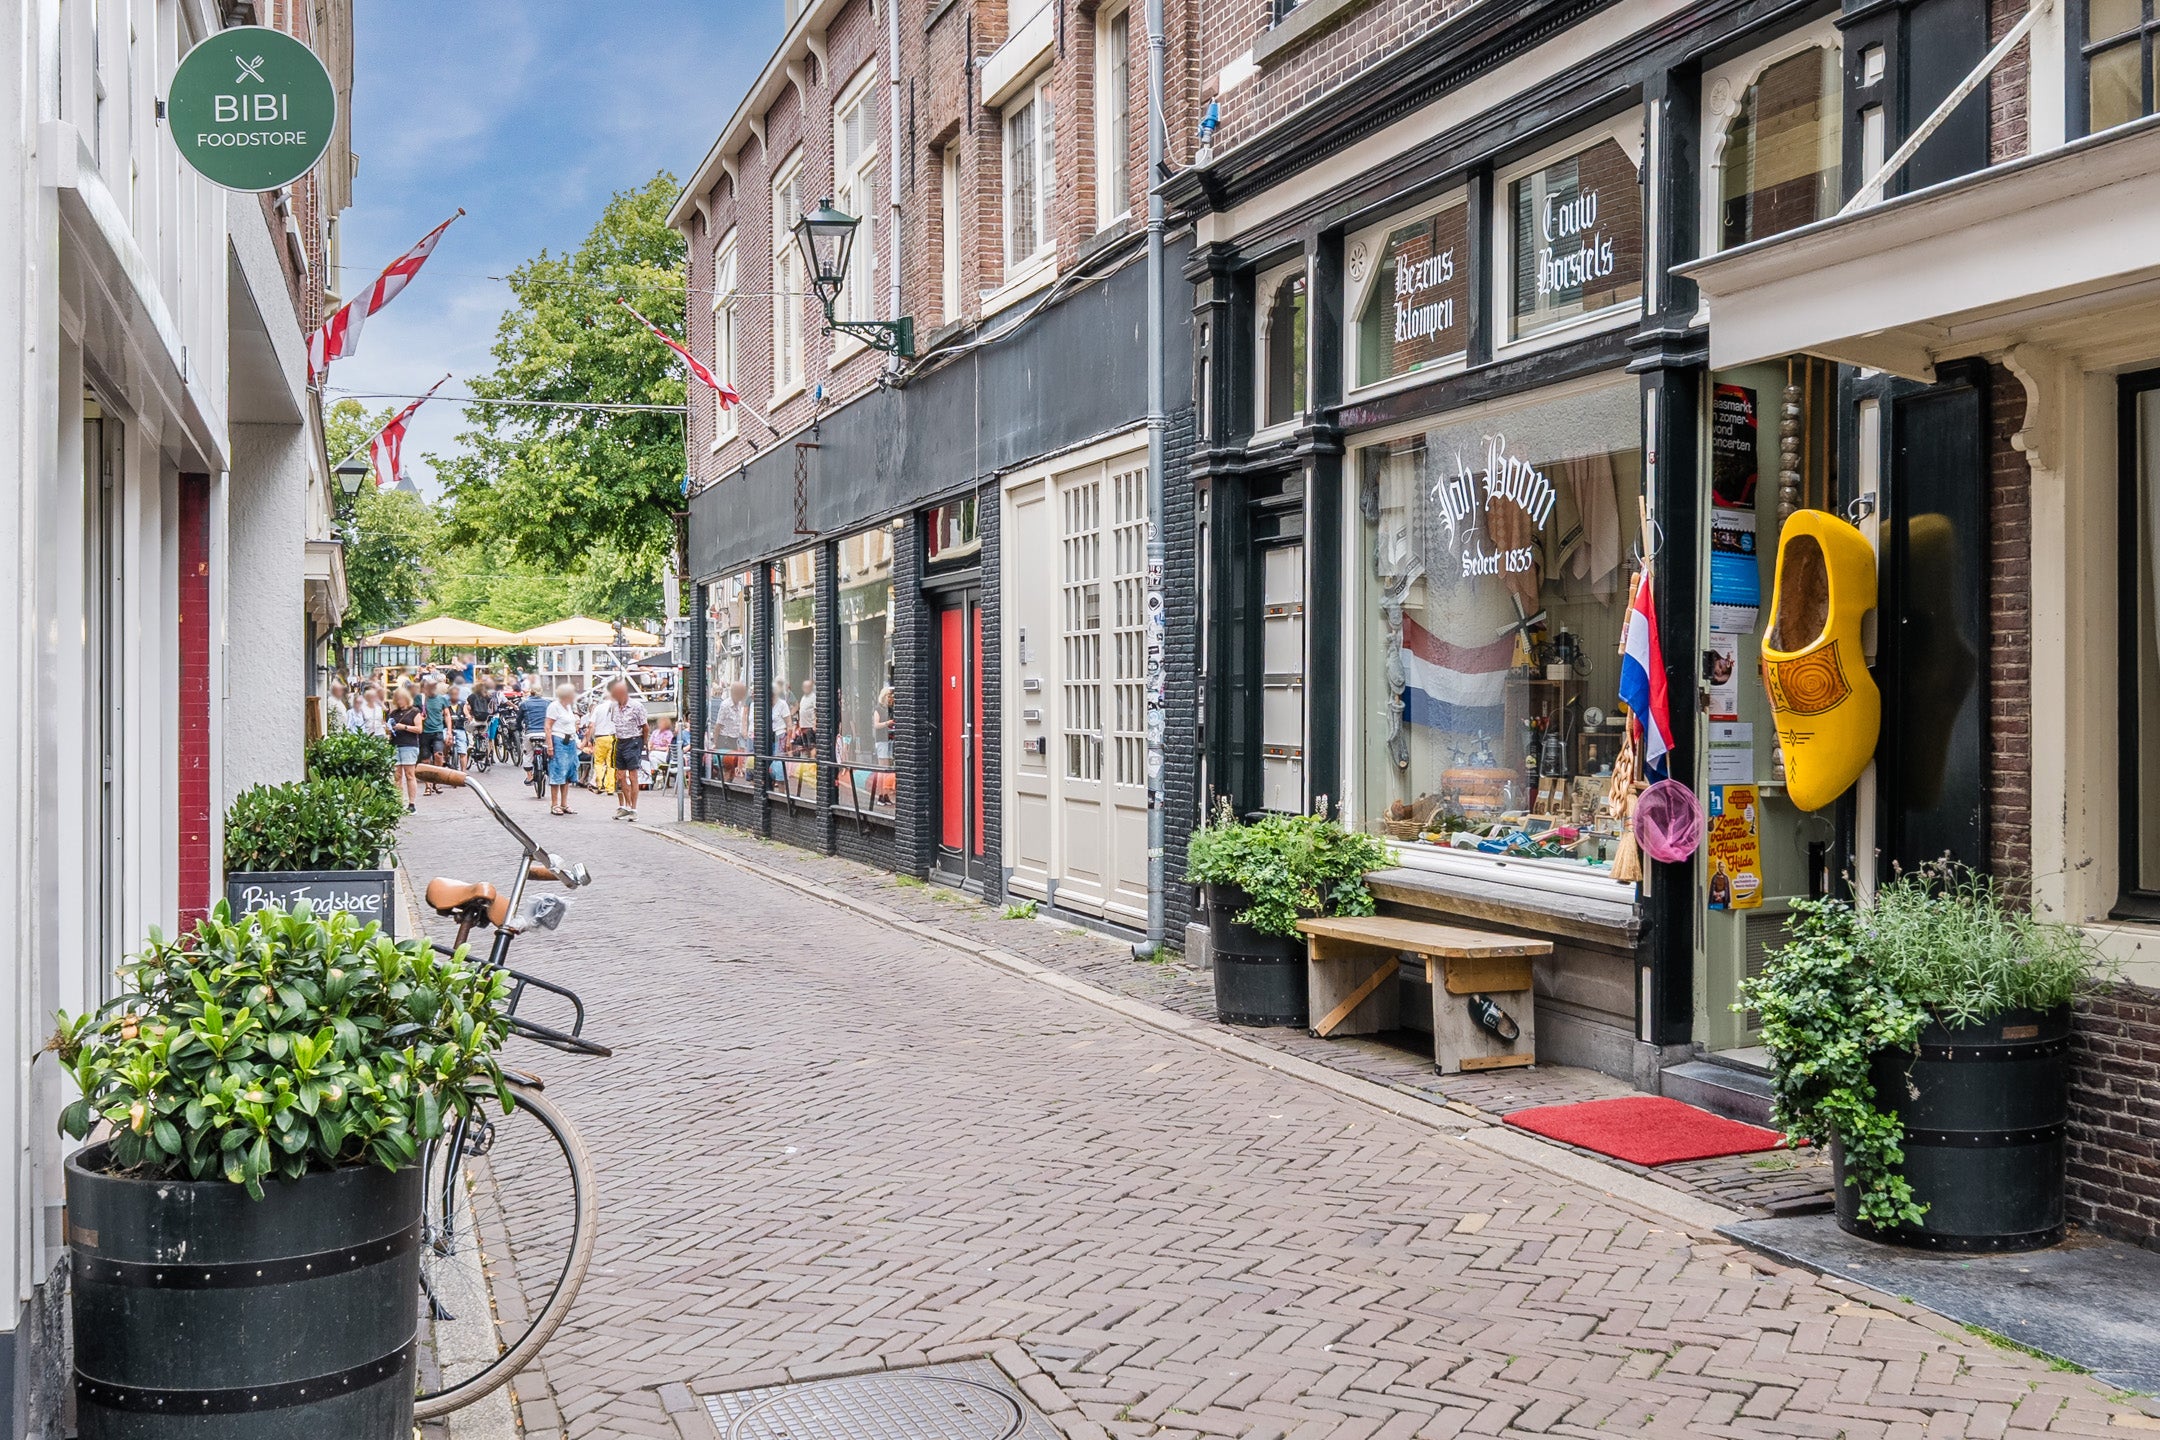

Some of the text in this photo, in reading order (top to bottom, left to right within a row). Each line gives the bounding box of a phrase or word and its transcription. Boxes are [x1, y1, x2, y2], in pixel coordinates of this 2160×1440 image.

[214, 93, 288, 122] BIBI
[197, 131, 307, 147] FOODSTORE
[1542, 184, 1599, 242] Touw
[1537, 229, 1613, 296] Borstels
[1394, 247, 1454, 301] Bezems
[1713, 399, 1753, 414] aasmarkt
[1719, 412, 1749, 425] zomer-
[1712, 424, 1733, 436] vond
[1712, 437, 1751, 451] oncerten
[1430, 432, 1556, 552] Joh. Boom
[1462, 540, 1502, 578] Sedert
[1505, 545, 1533, 573] 1835
[1715, 814, 1745, 832] Zomer
[1710, 827, 1748, 843] vakantie
[1708, 841, 1756, 860] in Huis van
[1727, 855, 1754, 873] Hilde
[241, 885, 381, 914] Bibi Fodstore
